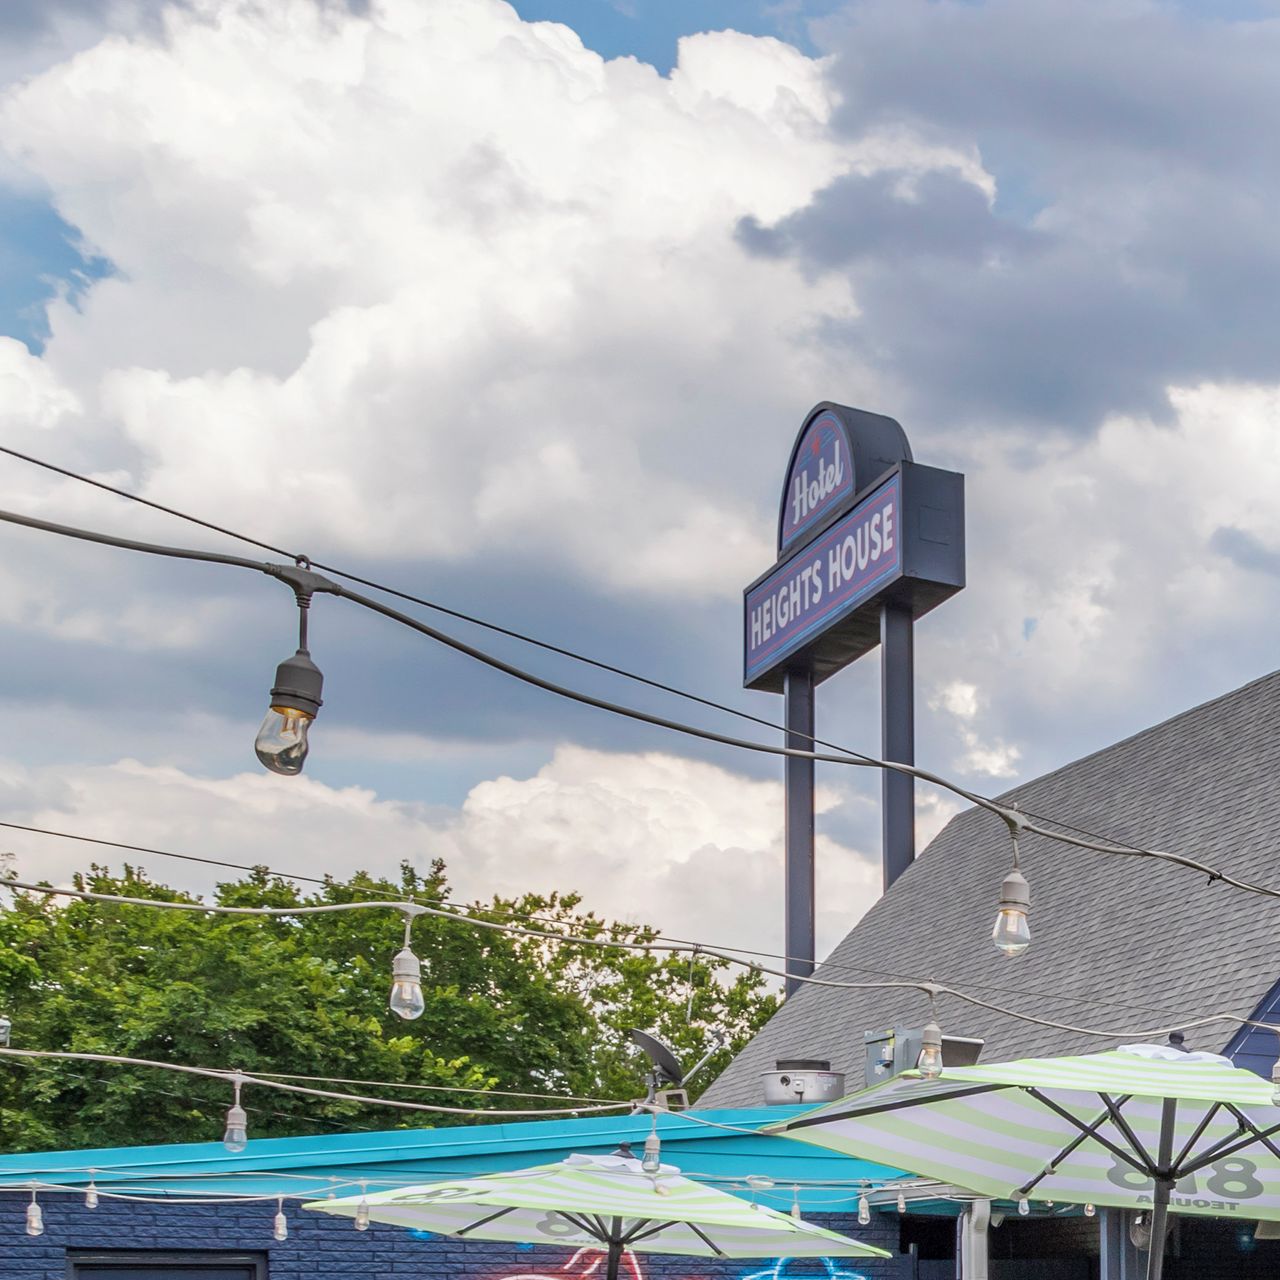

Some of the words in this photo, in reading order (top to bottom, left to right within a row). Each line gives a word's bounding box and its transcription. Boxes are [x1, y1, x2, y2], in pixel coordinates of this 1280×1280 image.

[792, 439, 844, 525] Hotel
[751, 559, 823, 650] HEIGHTS
[828, 503, 893, 593] HOUSE
